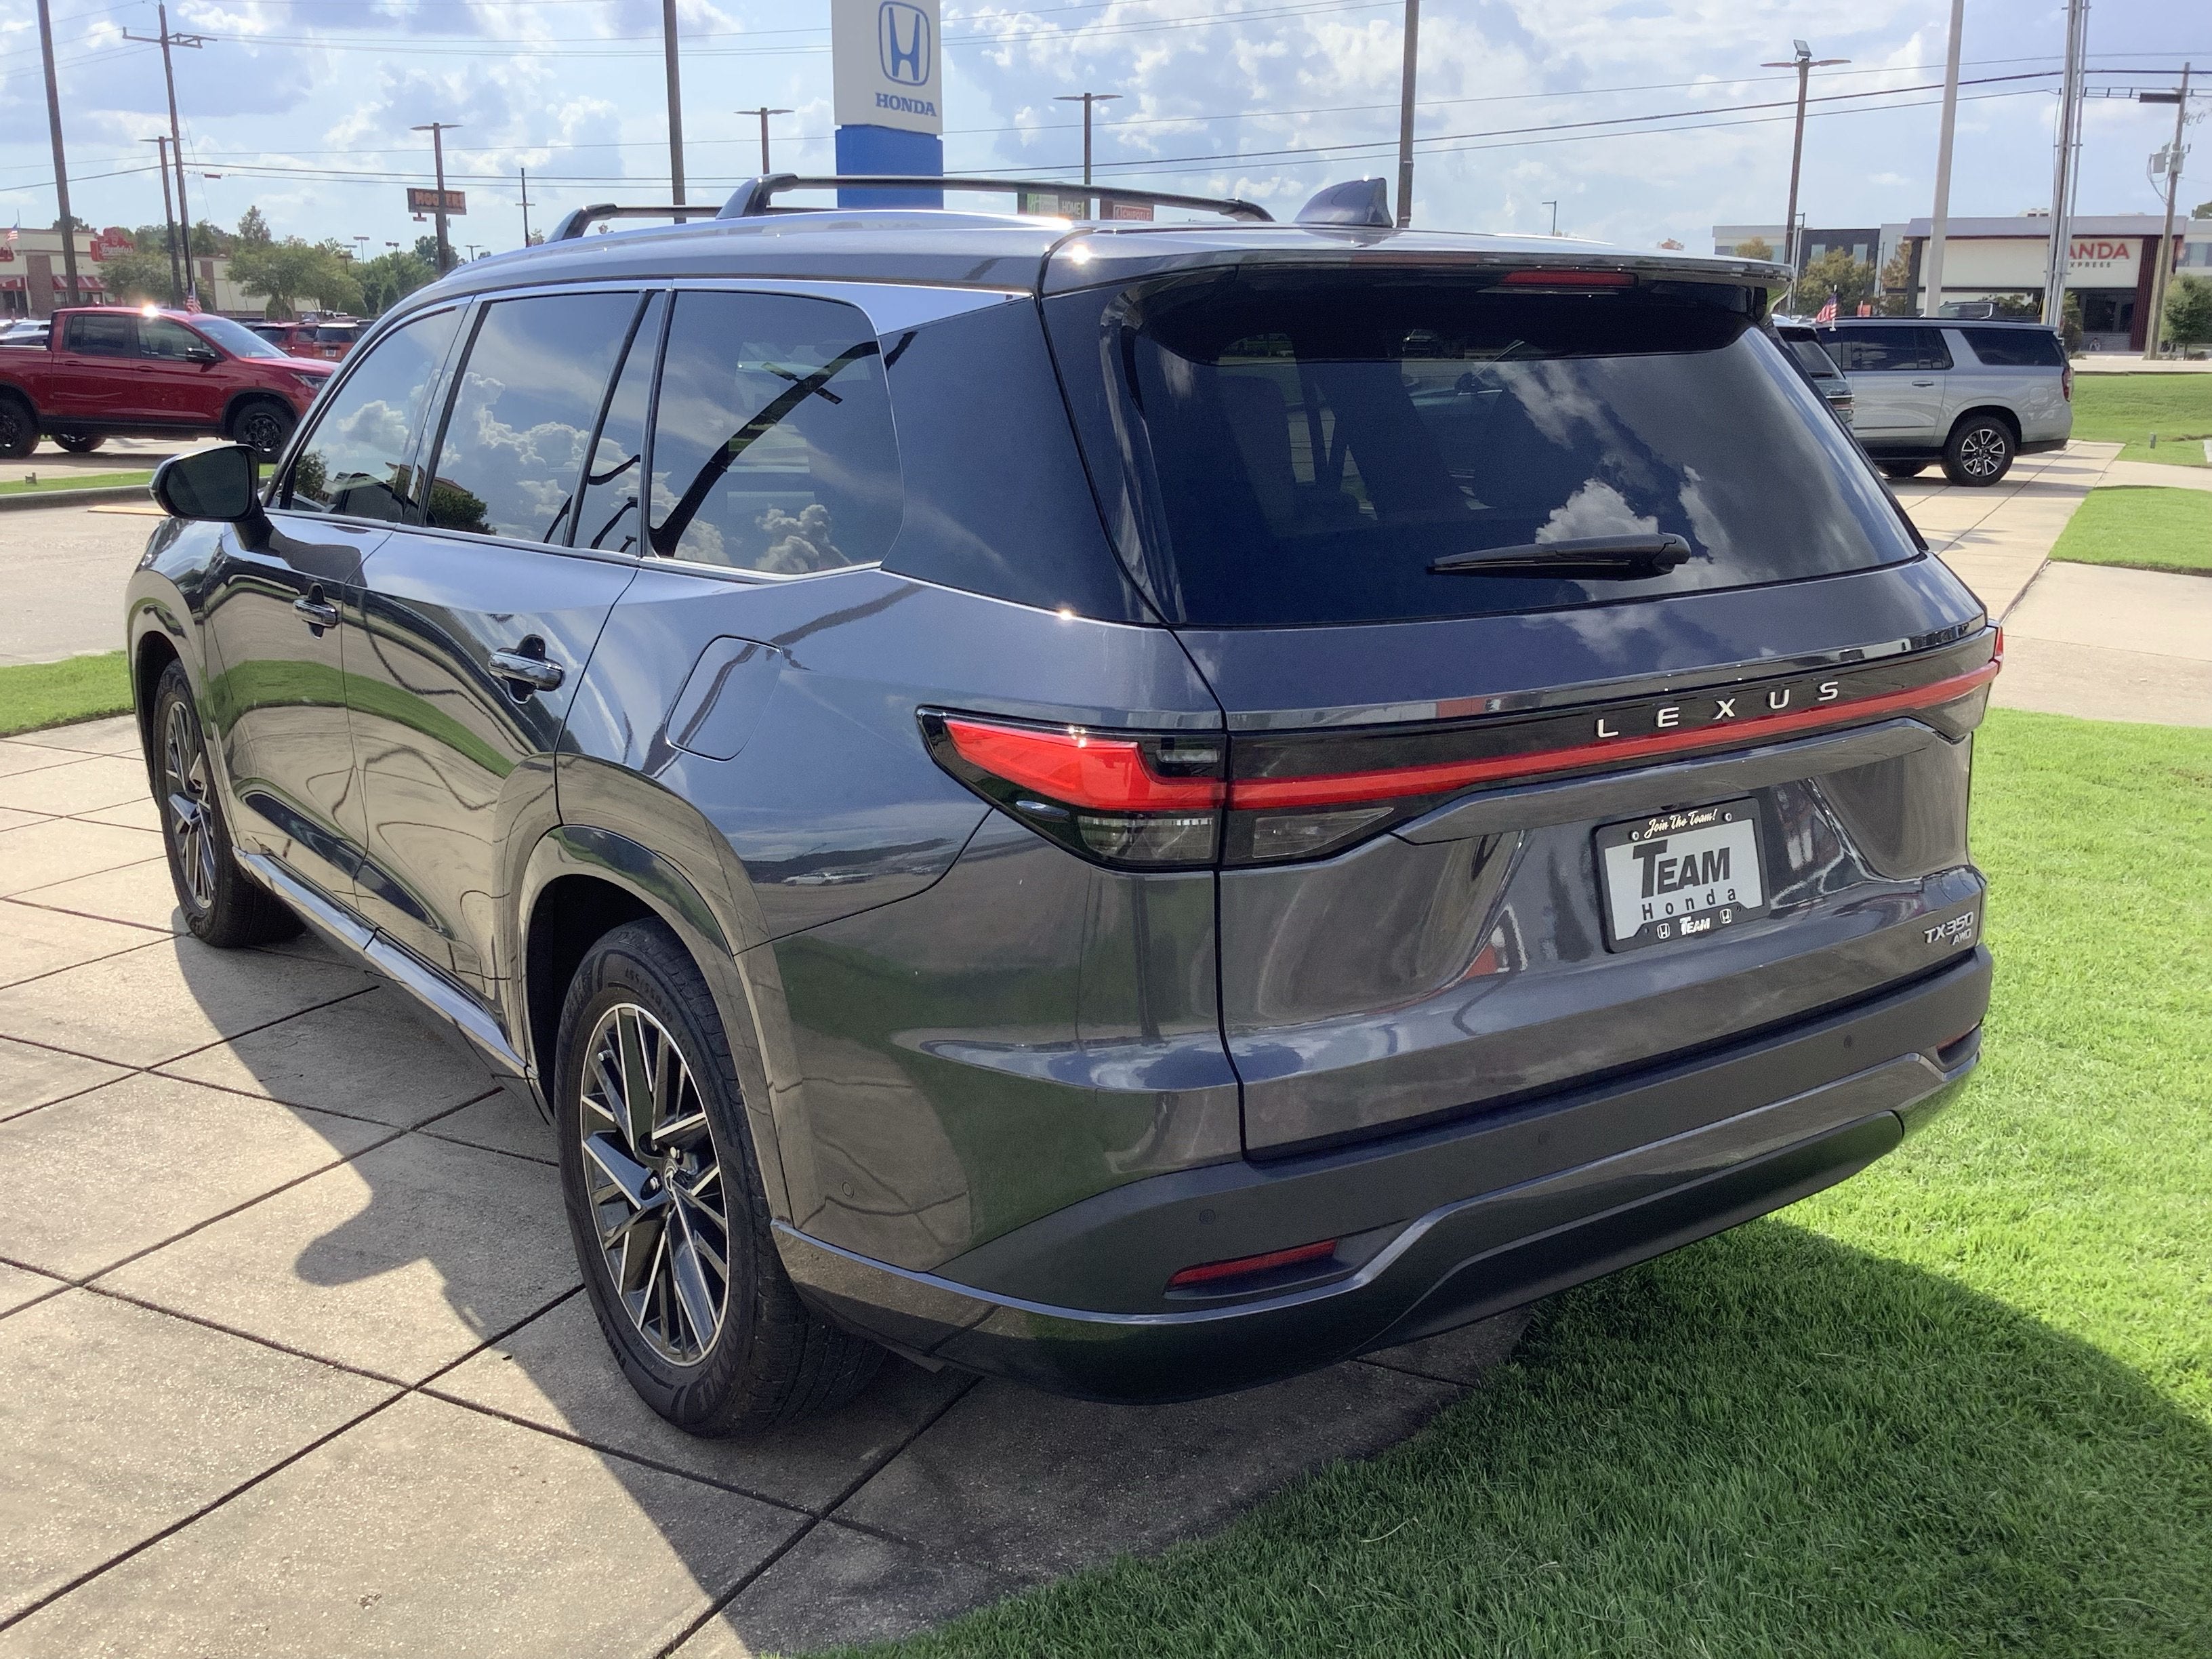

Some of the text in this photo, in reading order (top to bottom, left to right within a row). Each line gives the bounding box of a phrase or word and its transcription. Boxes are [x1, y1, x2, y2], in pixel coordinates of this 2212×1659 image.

[875, 92, 937, 117] HONDA
[414, 190, 464, 208] HOOERS
[2070, 242, 2129, 260] ANDA
[1595, 681, 1839, 739] LEXUS
[1644, 808, 1717, 838] Join The Team!
[1633, 840, 1730, 898] TEAM
[1641, 888, 1737, 921] Honda
[1679, 916, 1711, 936] TEAM
[1923, 912, 1974, 943] TX350
[1951, 928, 1971, 946] AWD
